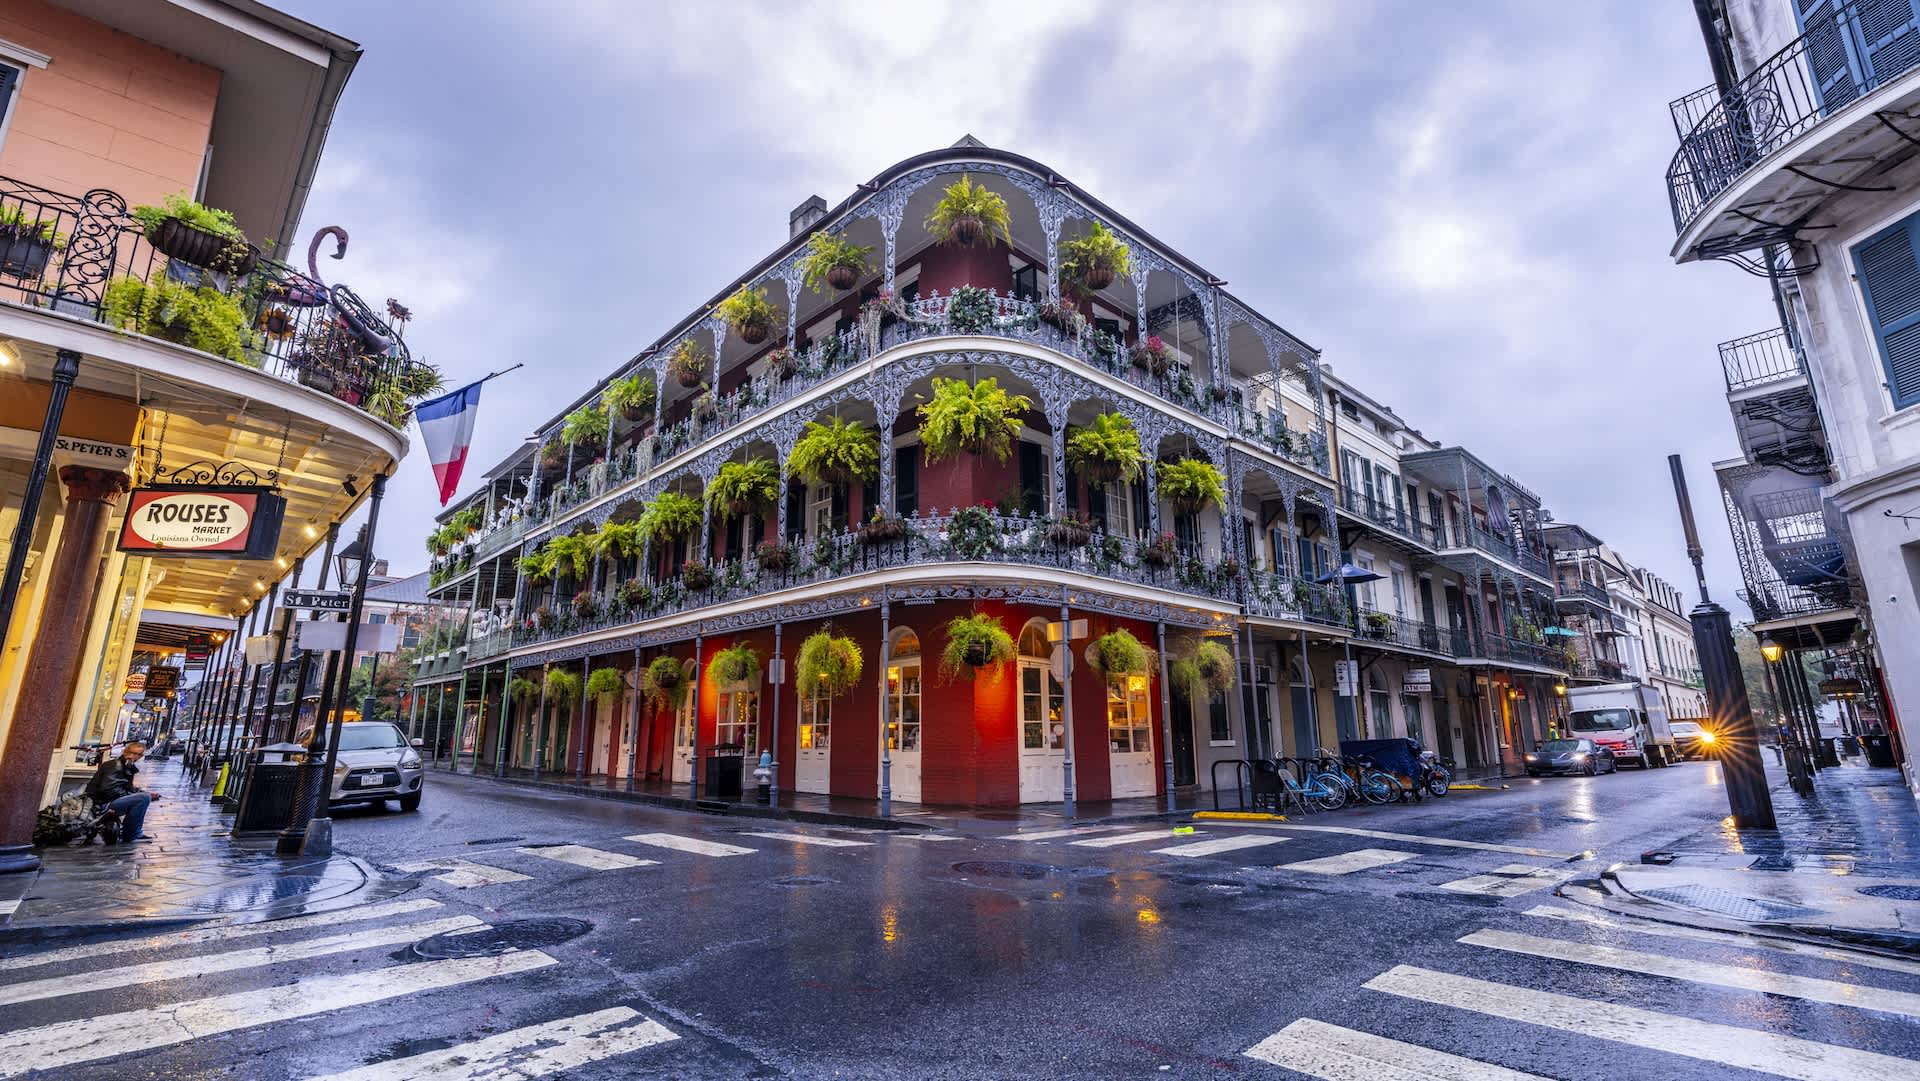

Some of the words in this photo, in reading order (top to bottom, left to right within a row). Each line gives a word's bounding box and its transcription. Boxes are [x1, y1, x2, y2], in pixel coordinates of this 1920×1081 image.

[71, 441, 113, 457] PETER
[146, 503, 230, 524] ROUSES
[192, 526, 232, 535] MARKET
[151, 533, 189, 543] Louisiana
[190, 534, 220, 543] Owned
[311, 596, 349, 608] Peter
